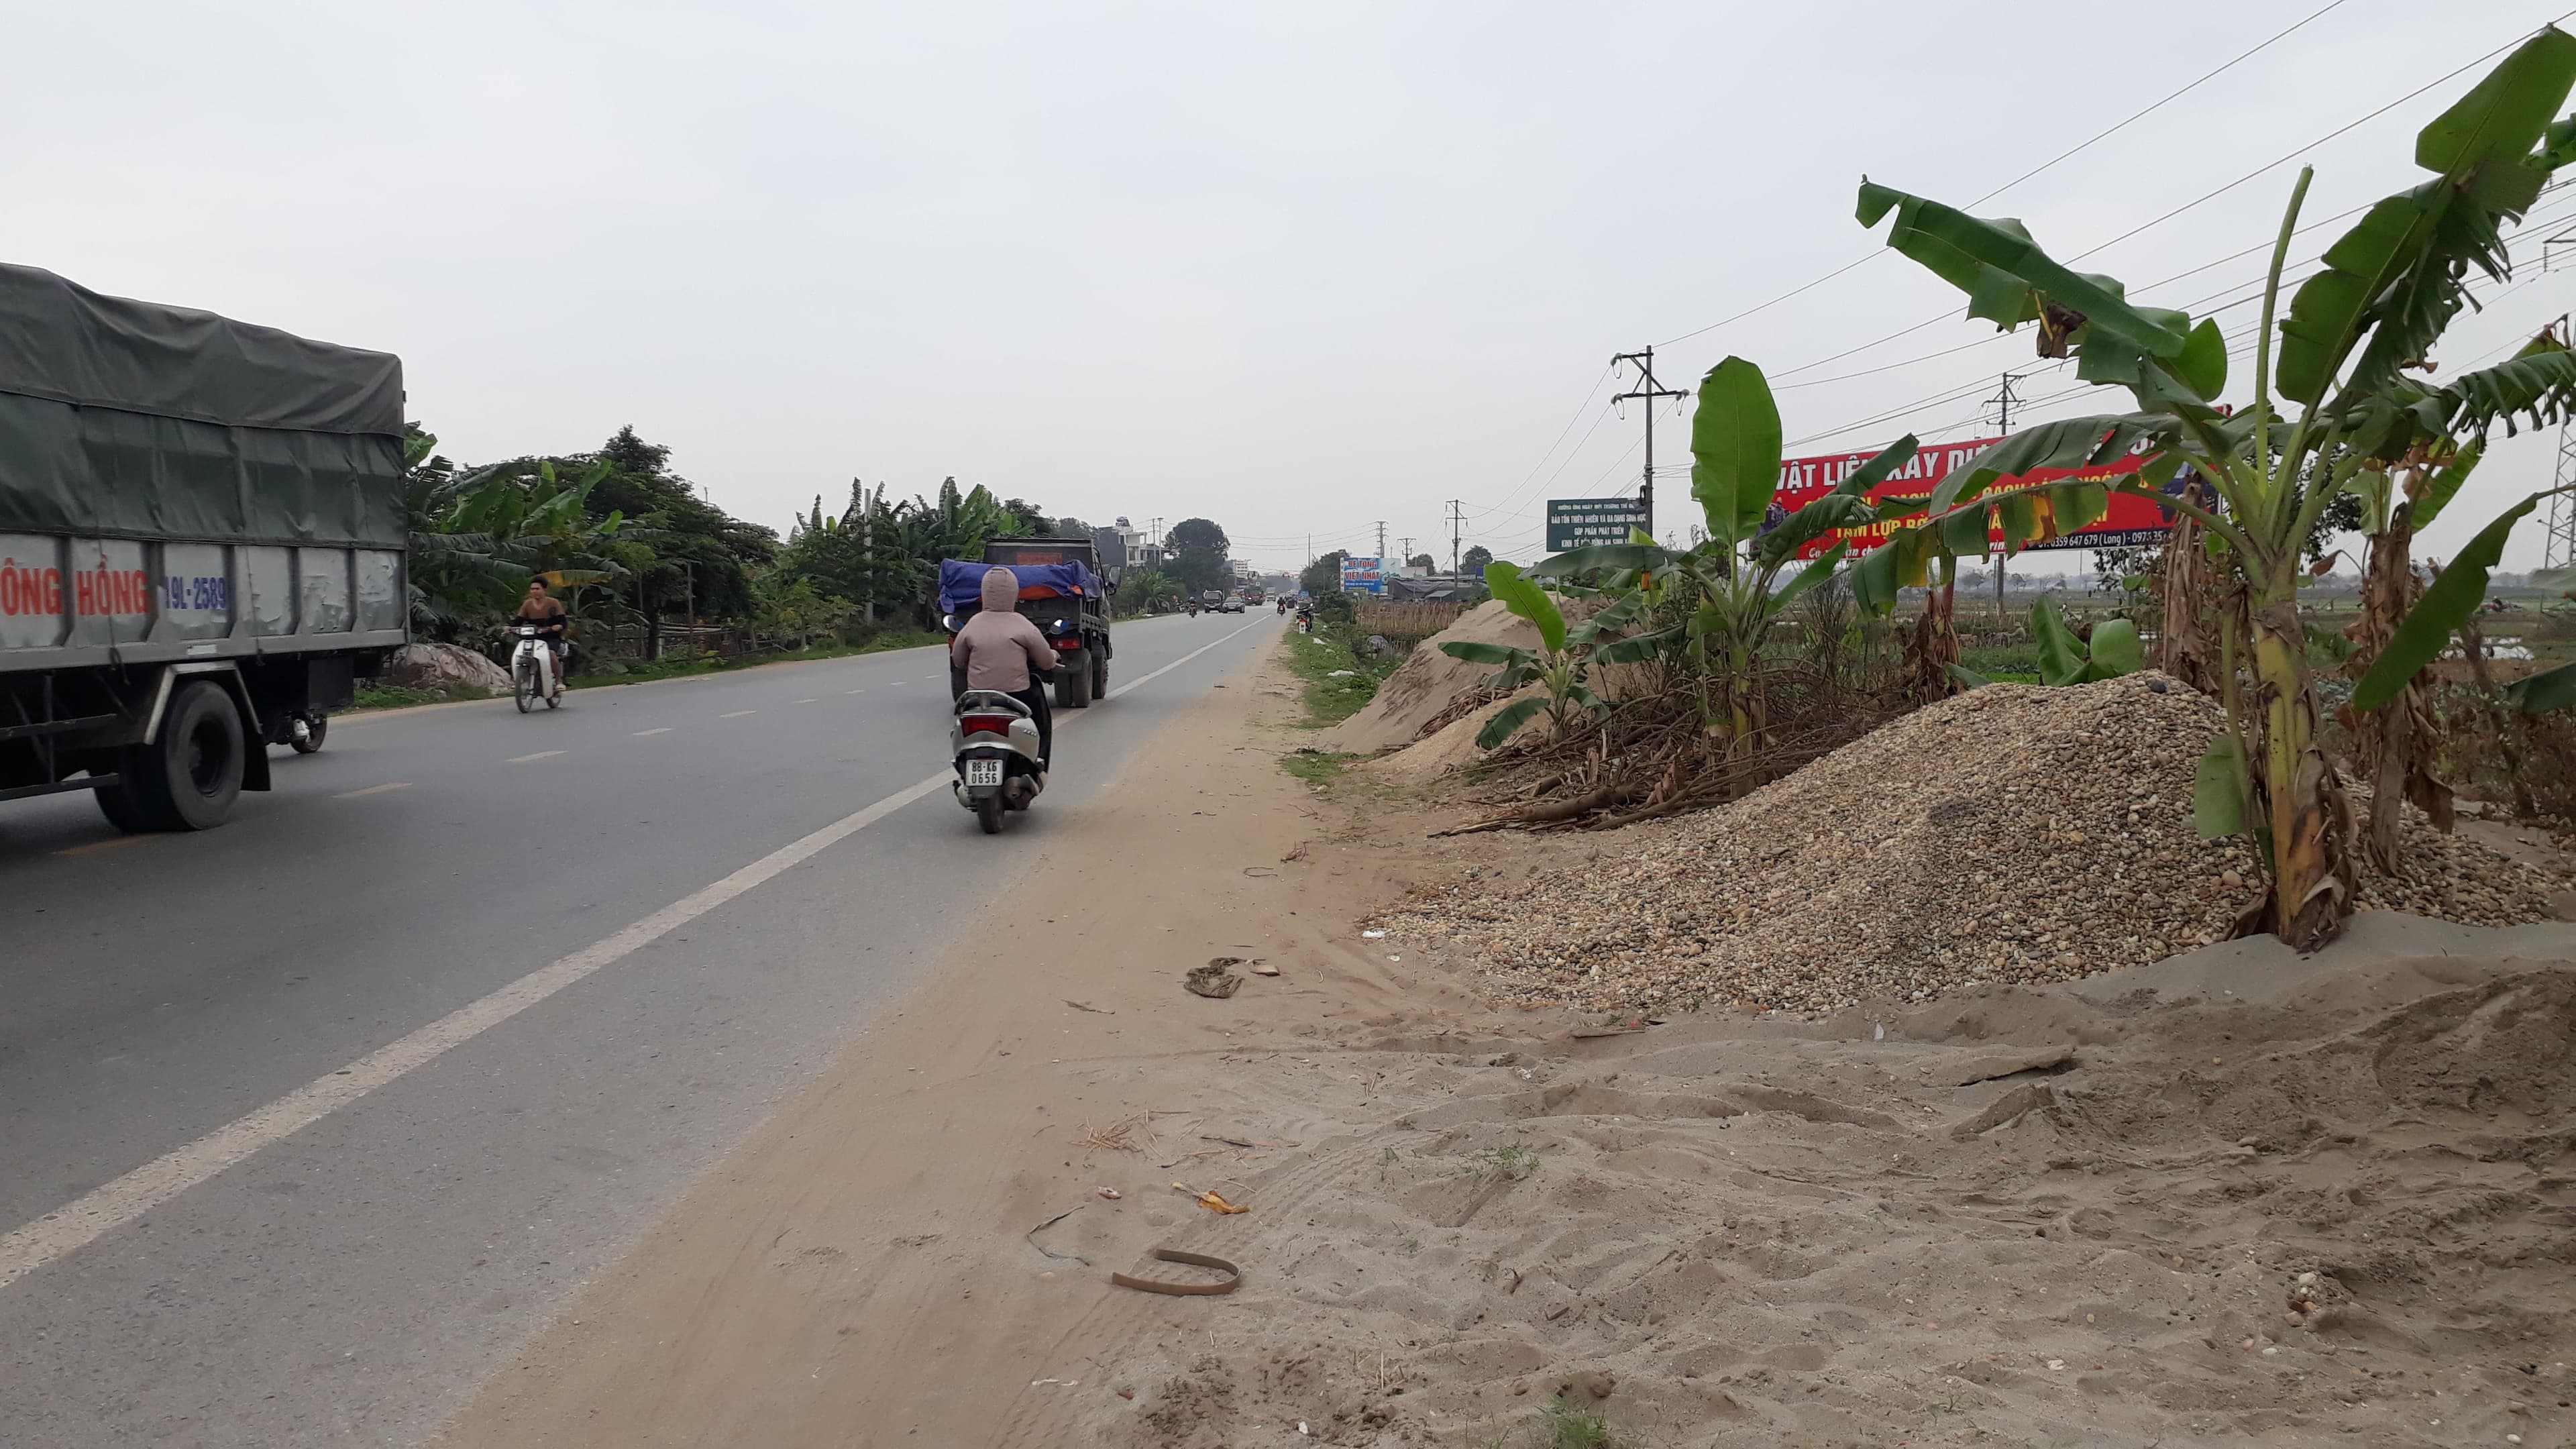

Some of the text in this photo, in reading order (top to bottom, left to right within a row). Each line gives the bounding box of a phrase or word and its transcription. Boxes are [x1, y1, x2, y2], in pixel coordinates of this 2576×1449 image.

[2069, 535, 2083, 546] 647
[2084, 534, 2098, 545] 679
[972, 773, 997, 784] 0656
